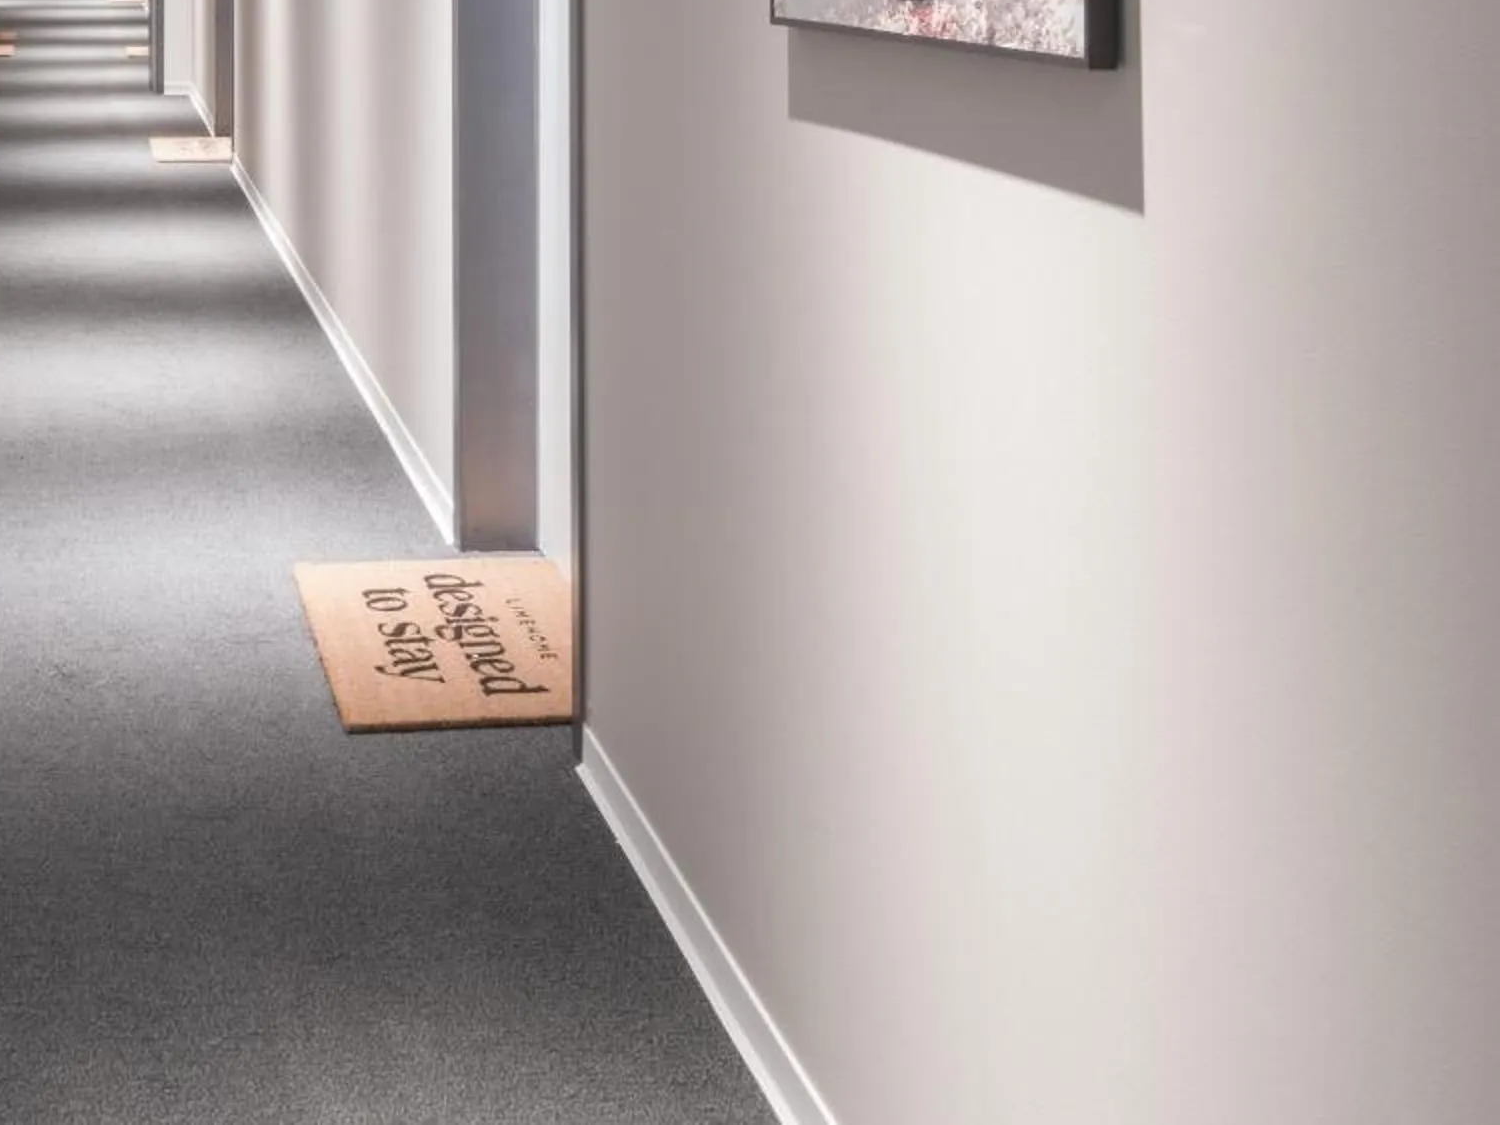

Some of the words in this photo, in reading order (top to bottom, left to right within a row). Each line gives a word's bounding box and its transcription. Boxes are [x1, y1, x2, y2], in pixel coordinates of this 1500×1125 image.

[362, 586, 411, 612] to
[375, 622, 445, 684] stay
[424, 573, 550, 697] designed
